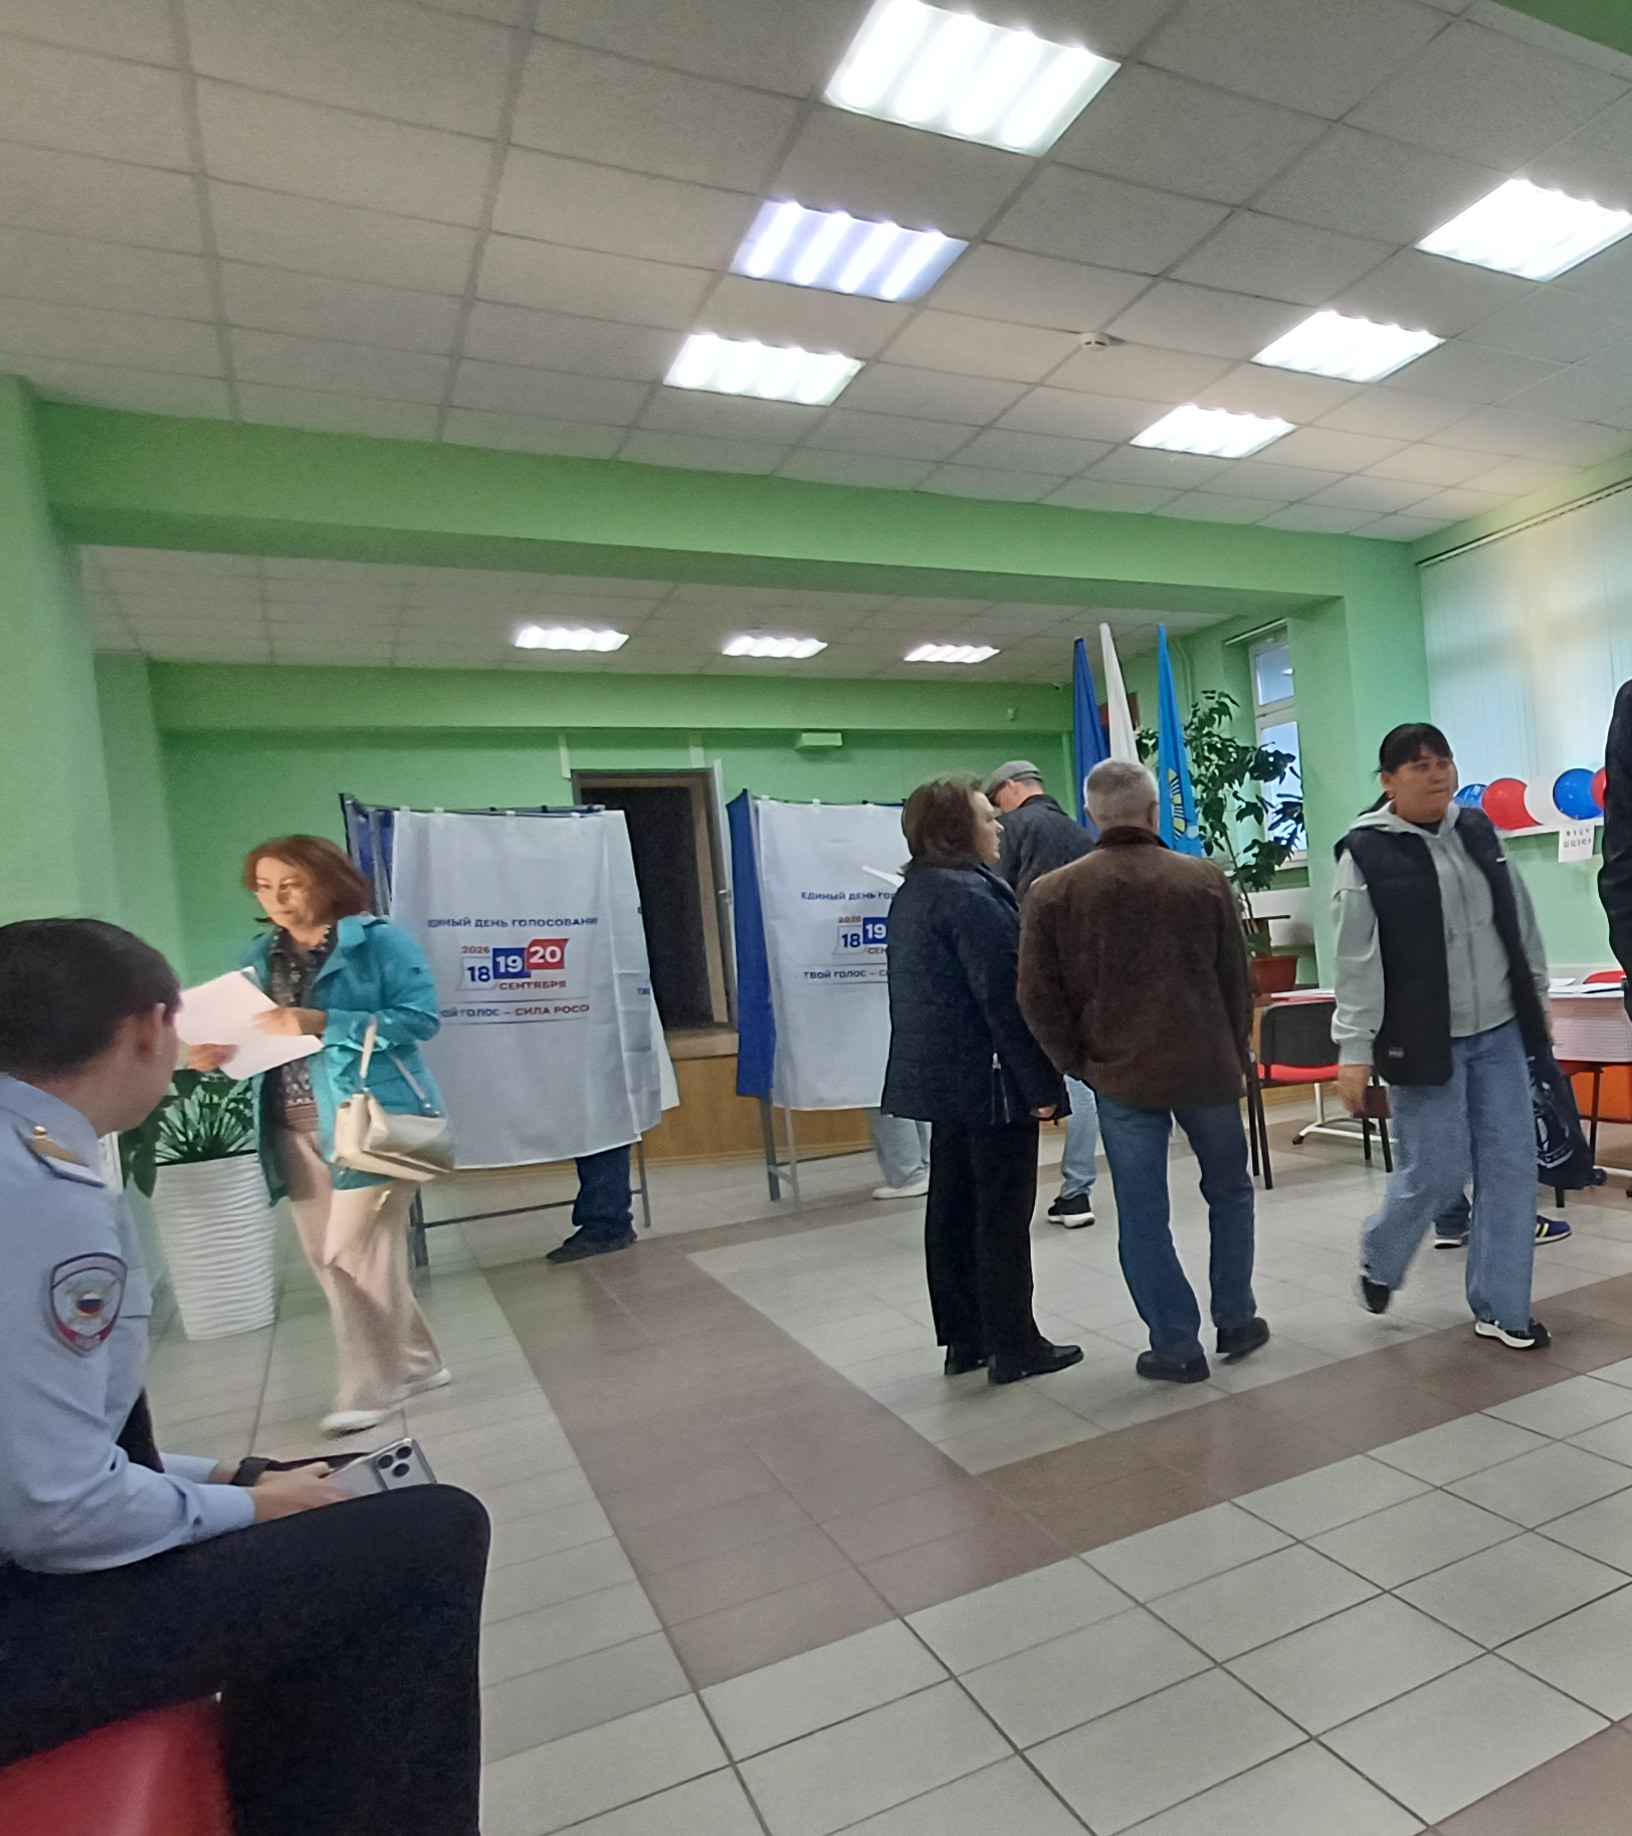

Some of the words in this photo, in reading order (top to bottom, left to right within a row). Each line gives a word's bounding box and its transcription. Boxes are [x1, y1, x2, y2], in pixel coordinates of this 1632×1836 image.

[848, 891, 876, 901] ДЕНЬ
[474, 918, 509, 928] ДЕНЬ
[841, 932, 861, 948] 18
[865, 923, 887, 939] 19
[461, 945, 491, 954] 2026
[466, 965, 492, 983] 18
[494, 955, 524, 974] 19
[528, 945, 563, 964] 20
[803, 969, 832, 979] ТВОЙ
[833, 969, 867, 979] ГОЛОС
[499, 979, 567, 991] СЕНТЯБРЯ
[514, 1006, 551, 1016] СИЛА
